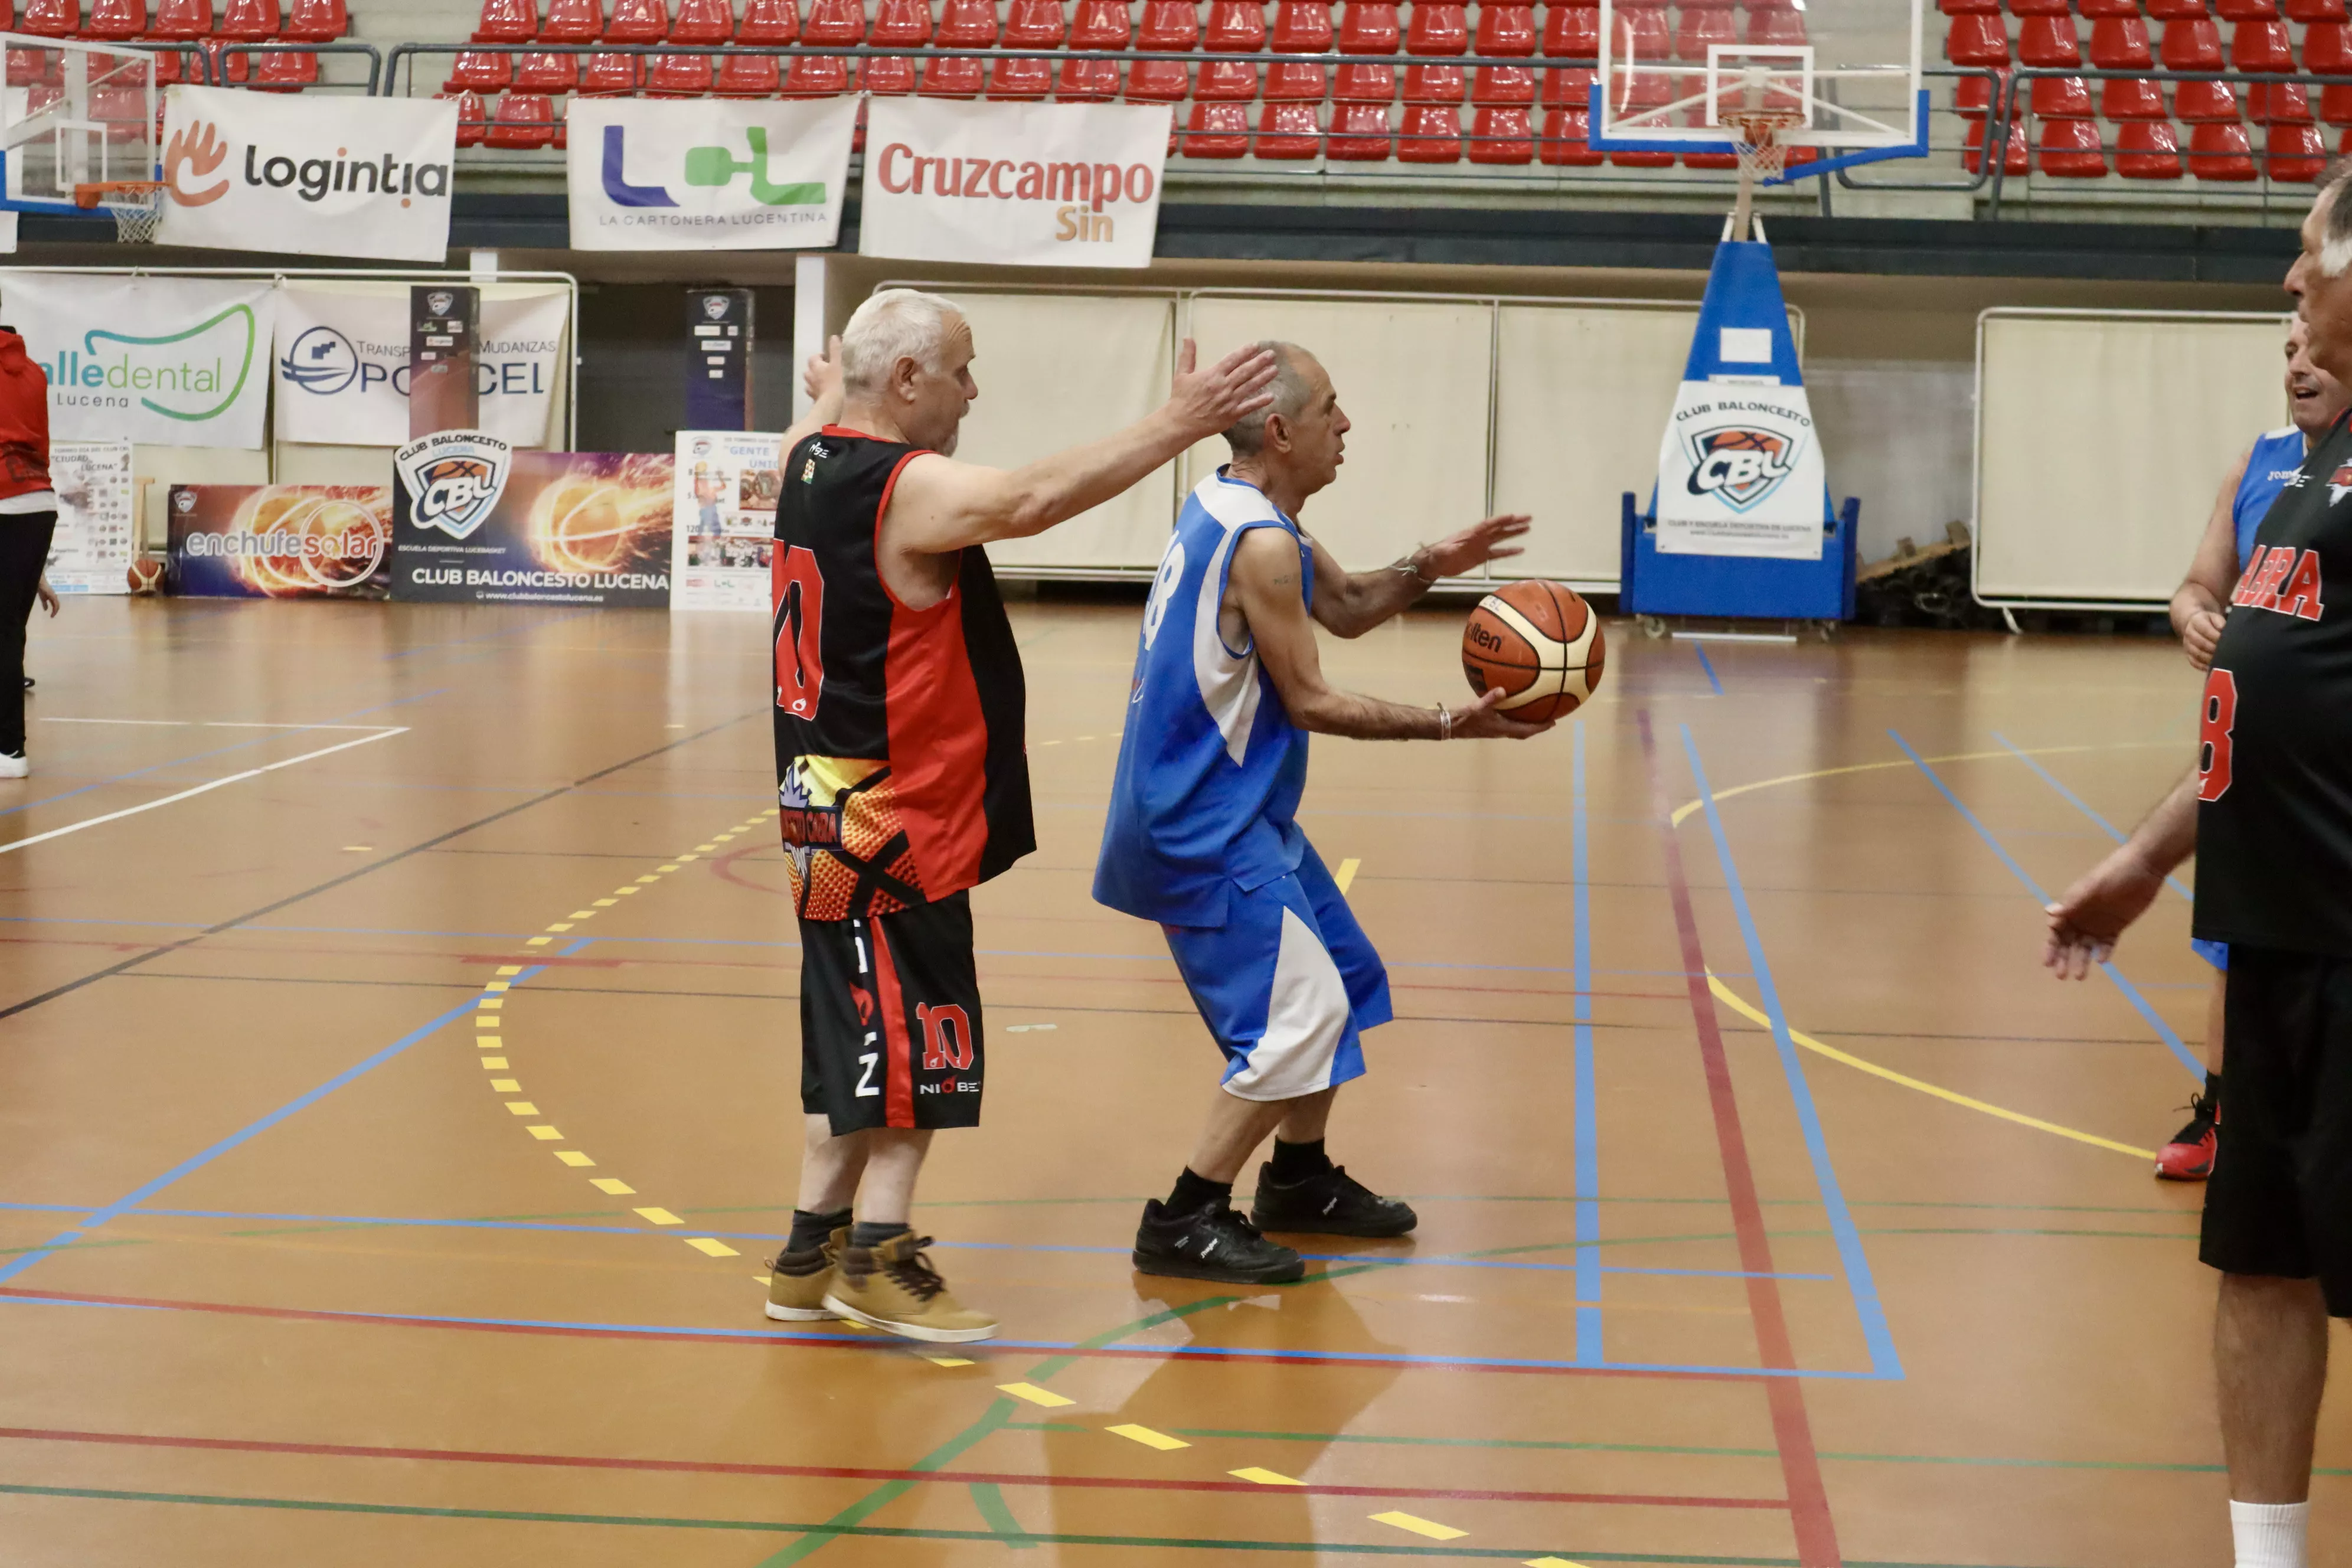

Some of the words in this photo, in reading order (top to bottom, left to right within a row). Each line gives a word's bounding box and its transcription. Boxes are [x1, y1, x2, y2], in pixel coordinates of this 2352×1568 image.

[245, 144, 449, 208] logintia
[878, 143, 1154, 213] Cruzcampo
[600, 215, 617, 226] LA
[623, 214, 726, 226] CARTONERA
[732, 212, 827, 225] LUCENTINA
[1056, 205, 1113, 242] Sin
[357, 341, 409, 358] TRANSP
[479, 341, 556, 354] MUDANZAS
[38, 351, 221, 393] alledental
[57, 393, 129, 408] Lucena
[1675, 404, 1711, 422] CLUB
[1717, 401, 1810, 426] BALONCESTO
[399, 441, 428, 461] CLUB
[432, 435, 507, 451] BALONCESTO
[186, 530, 378, 559] enchufesolar
[411, 568, 463, 585] CLUB
[466, 570, 590, 588] BALONCESTO
[594, 573, 669, 590] LUCENA
[1144, 530, 1185, 651] 8
[1468, 622, 1502, 653] lten
[916, 1002, 974, 1070] 10
